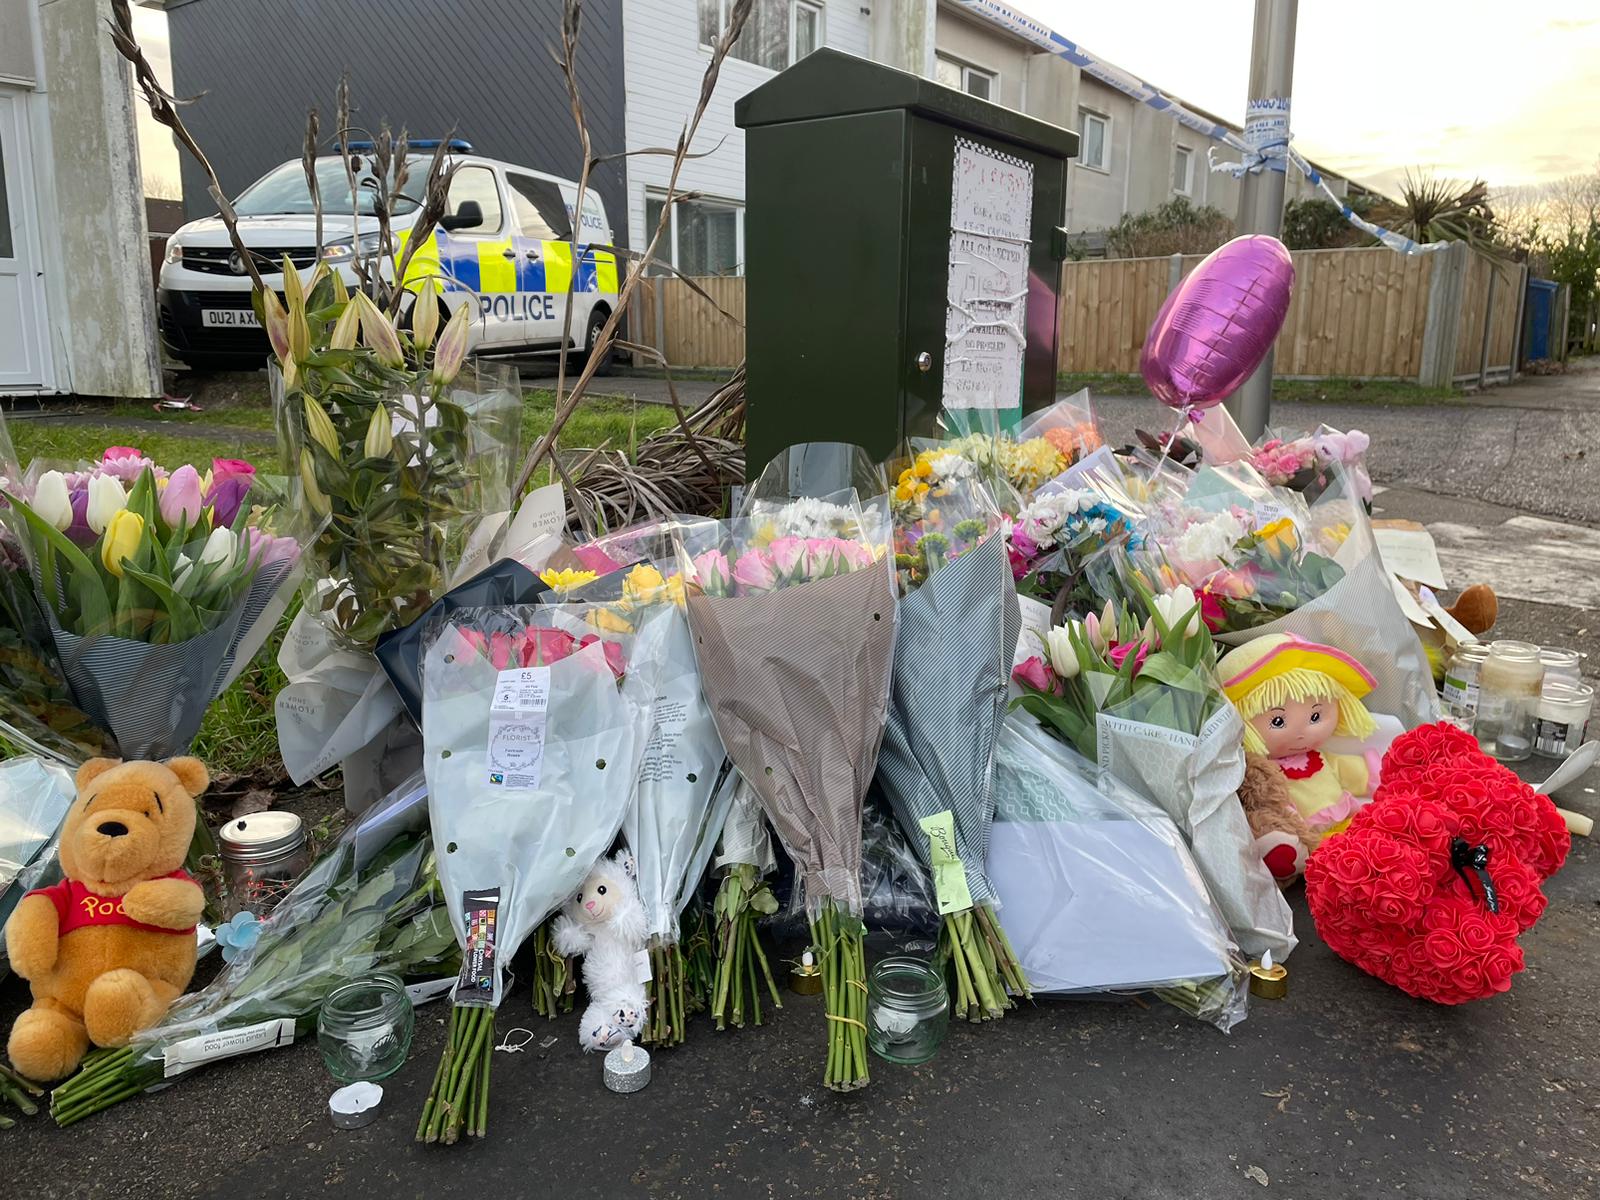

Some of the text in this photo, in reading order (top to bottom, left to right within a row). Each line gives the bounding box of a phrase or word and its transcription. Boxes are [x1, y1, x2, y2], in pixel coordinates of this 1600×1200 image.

[580, 214, 603, 230] OLICE
[478, 294, 556, 322] POLICE
[209, 311, 259, 326] OU21 AX
[520, 671, 532, 680] £5
[502, 734, 532, 742] FLORIST
[1132, 724, 1161, 738] CARE
[80, 896, 128, 918] Poo
[204, 1042, 221, 1052] food
[222, 1037, 246, 1049] flower
